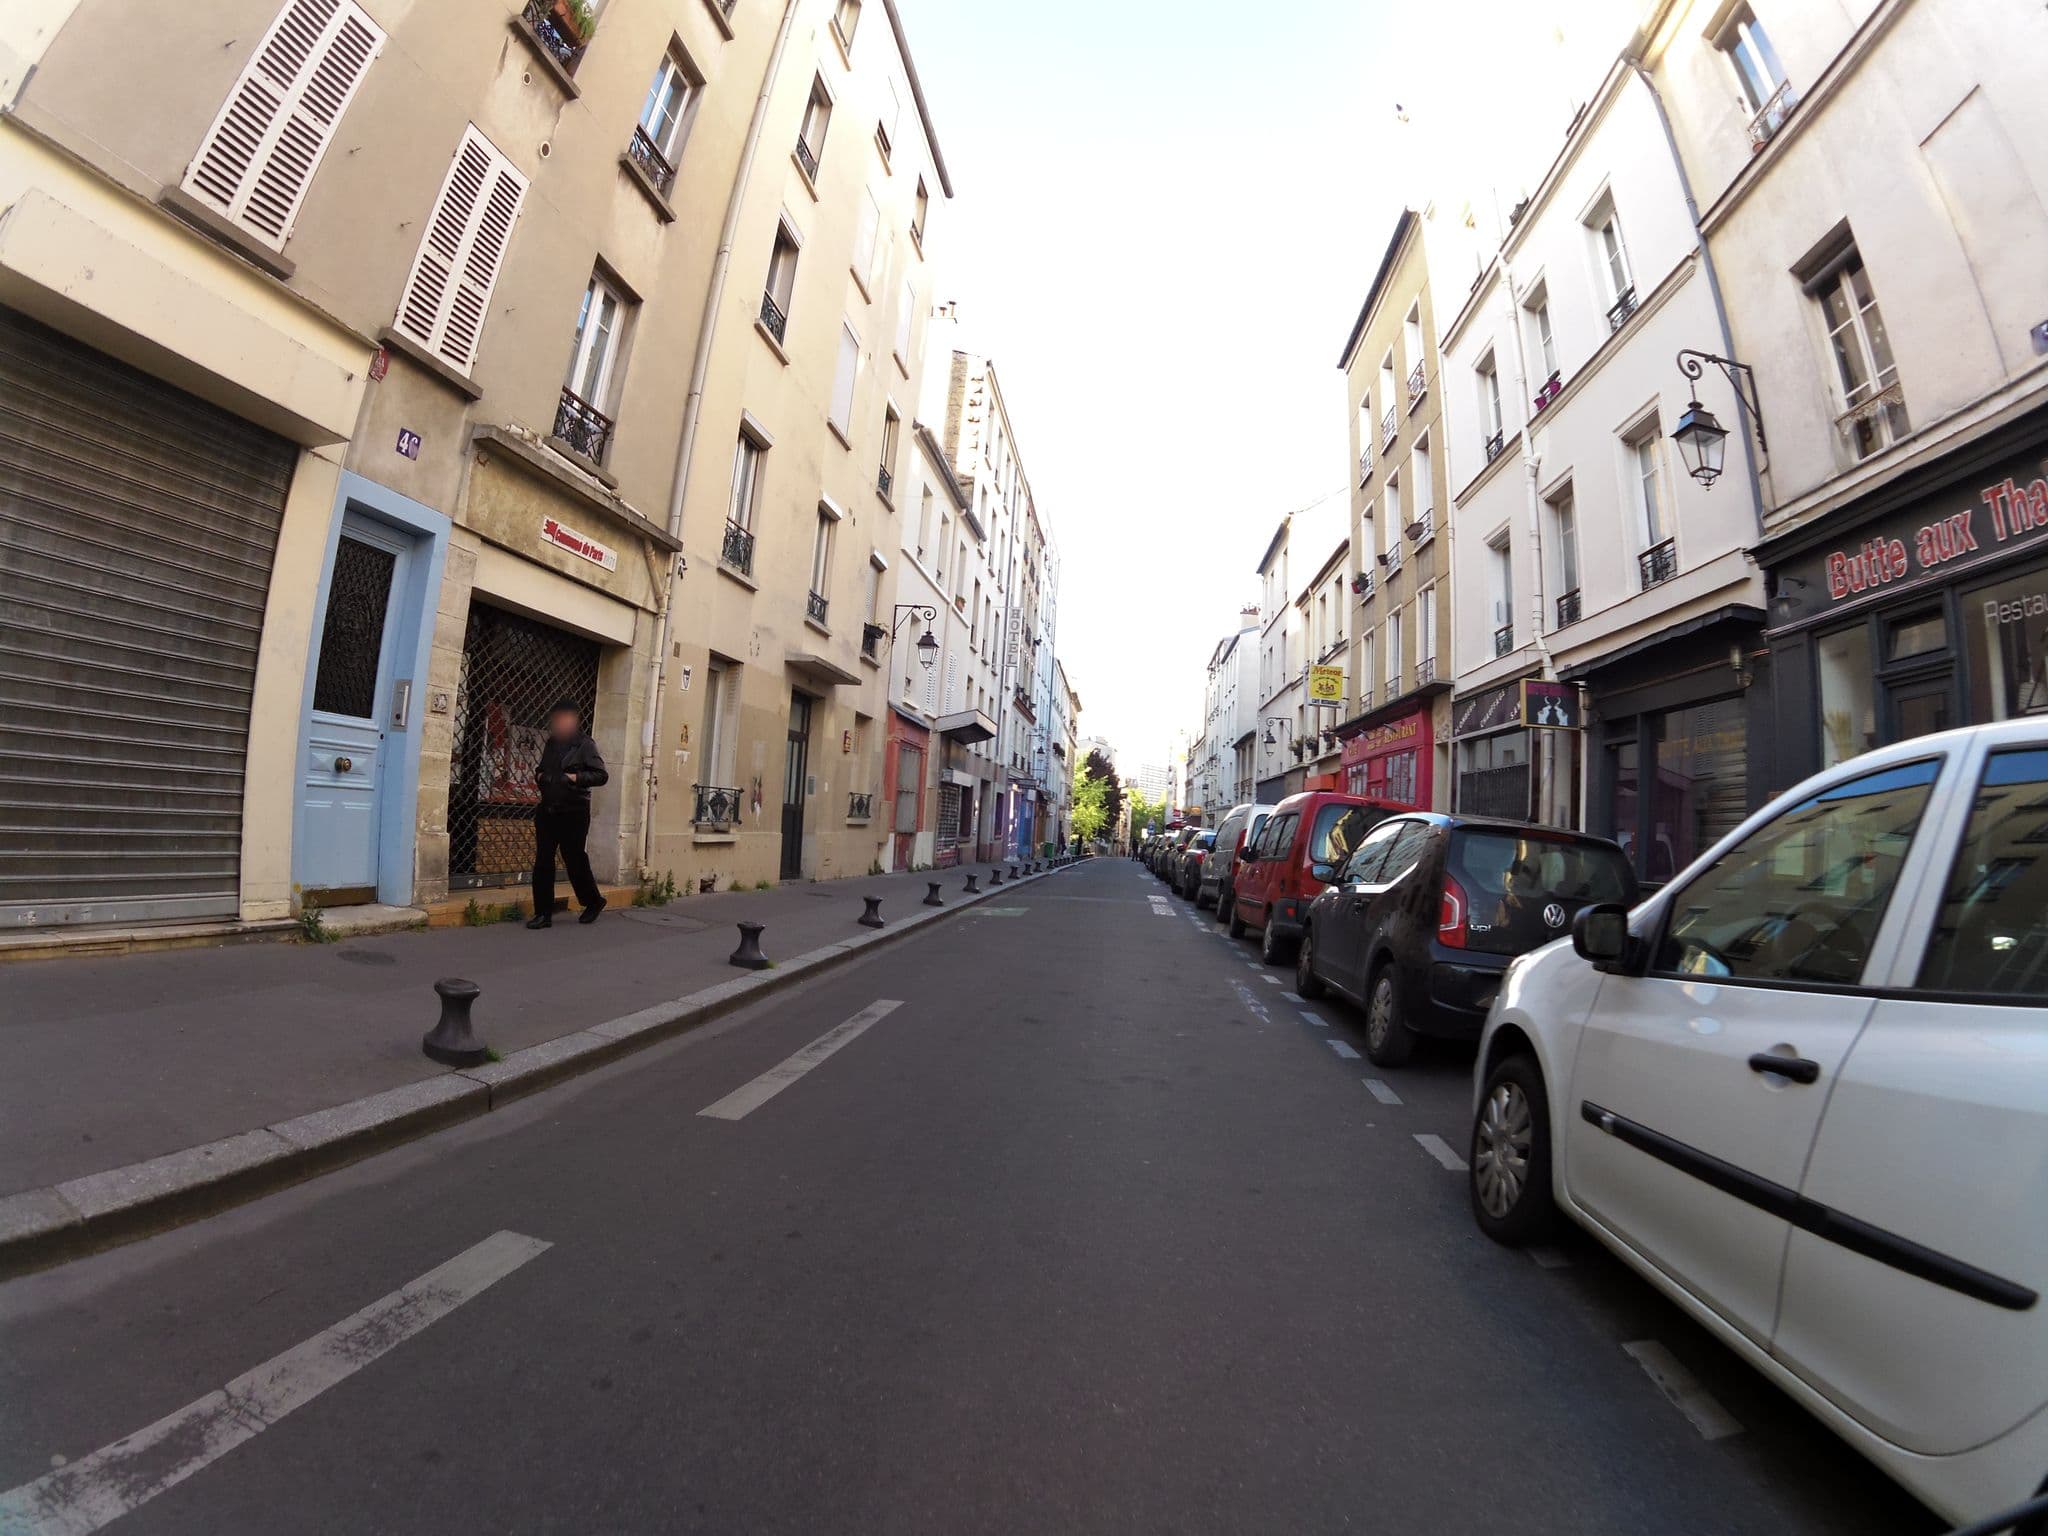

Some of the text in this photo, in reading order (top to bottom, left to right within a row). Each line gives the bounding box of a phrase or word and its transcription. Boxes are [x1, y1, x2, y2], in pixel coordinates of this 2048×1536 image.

[1826, 536, 1908, 600] Butte
[1915, 510, 1979, 568] aux
[1008, 609, 1021, 665] HOTEL
